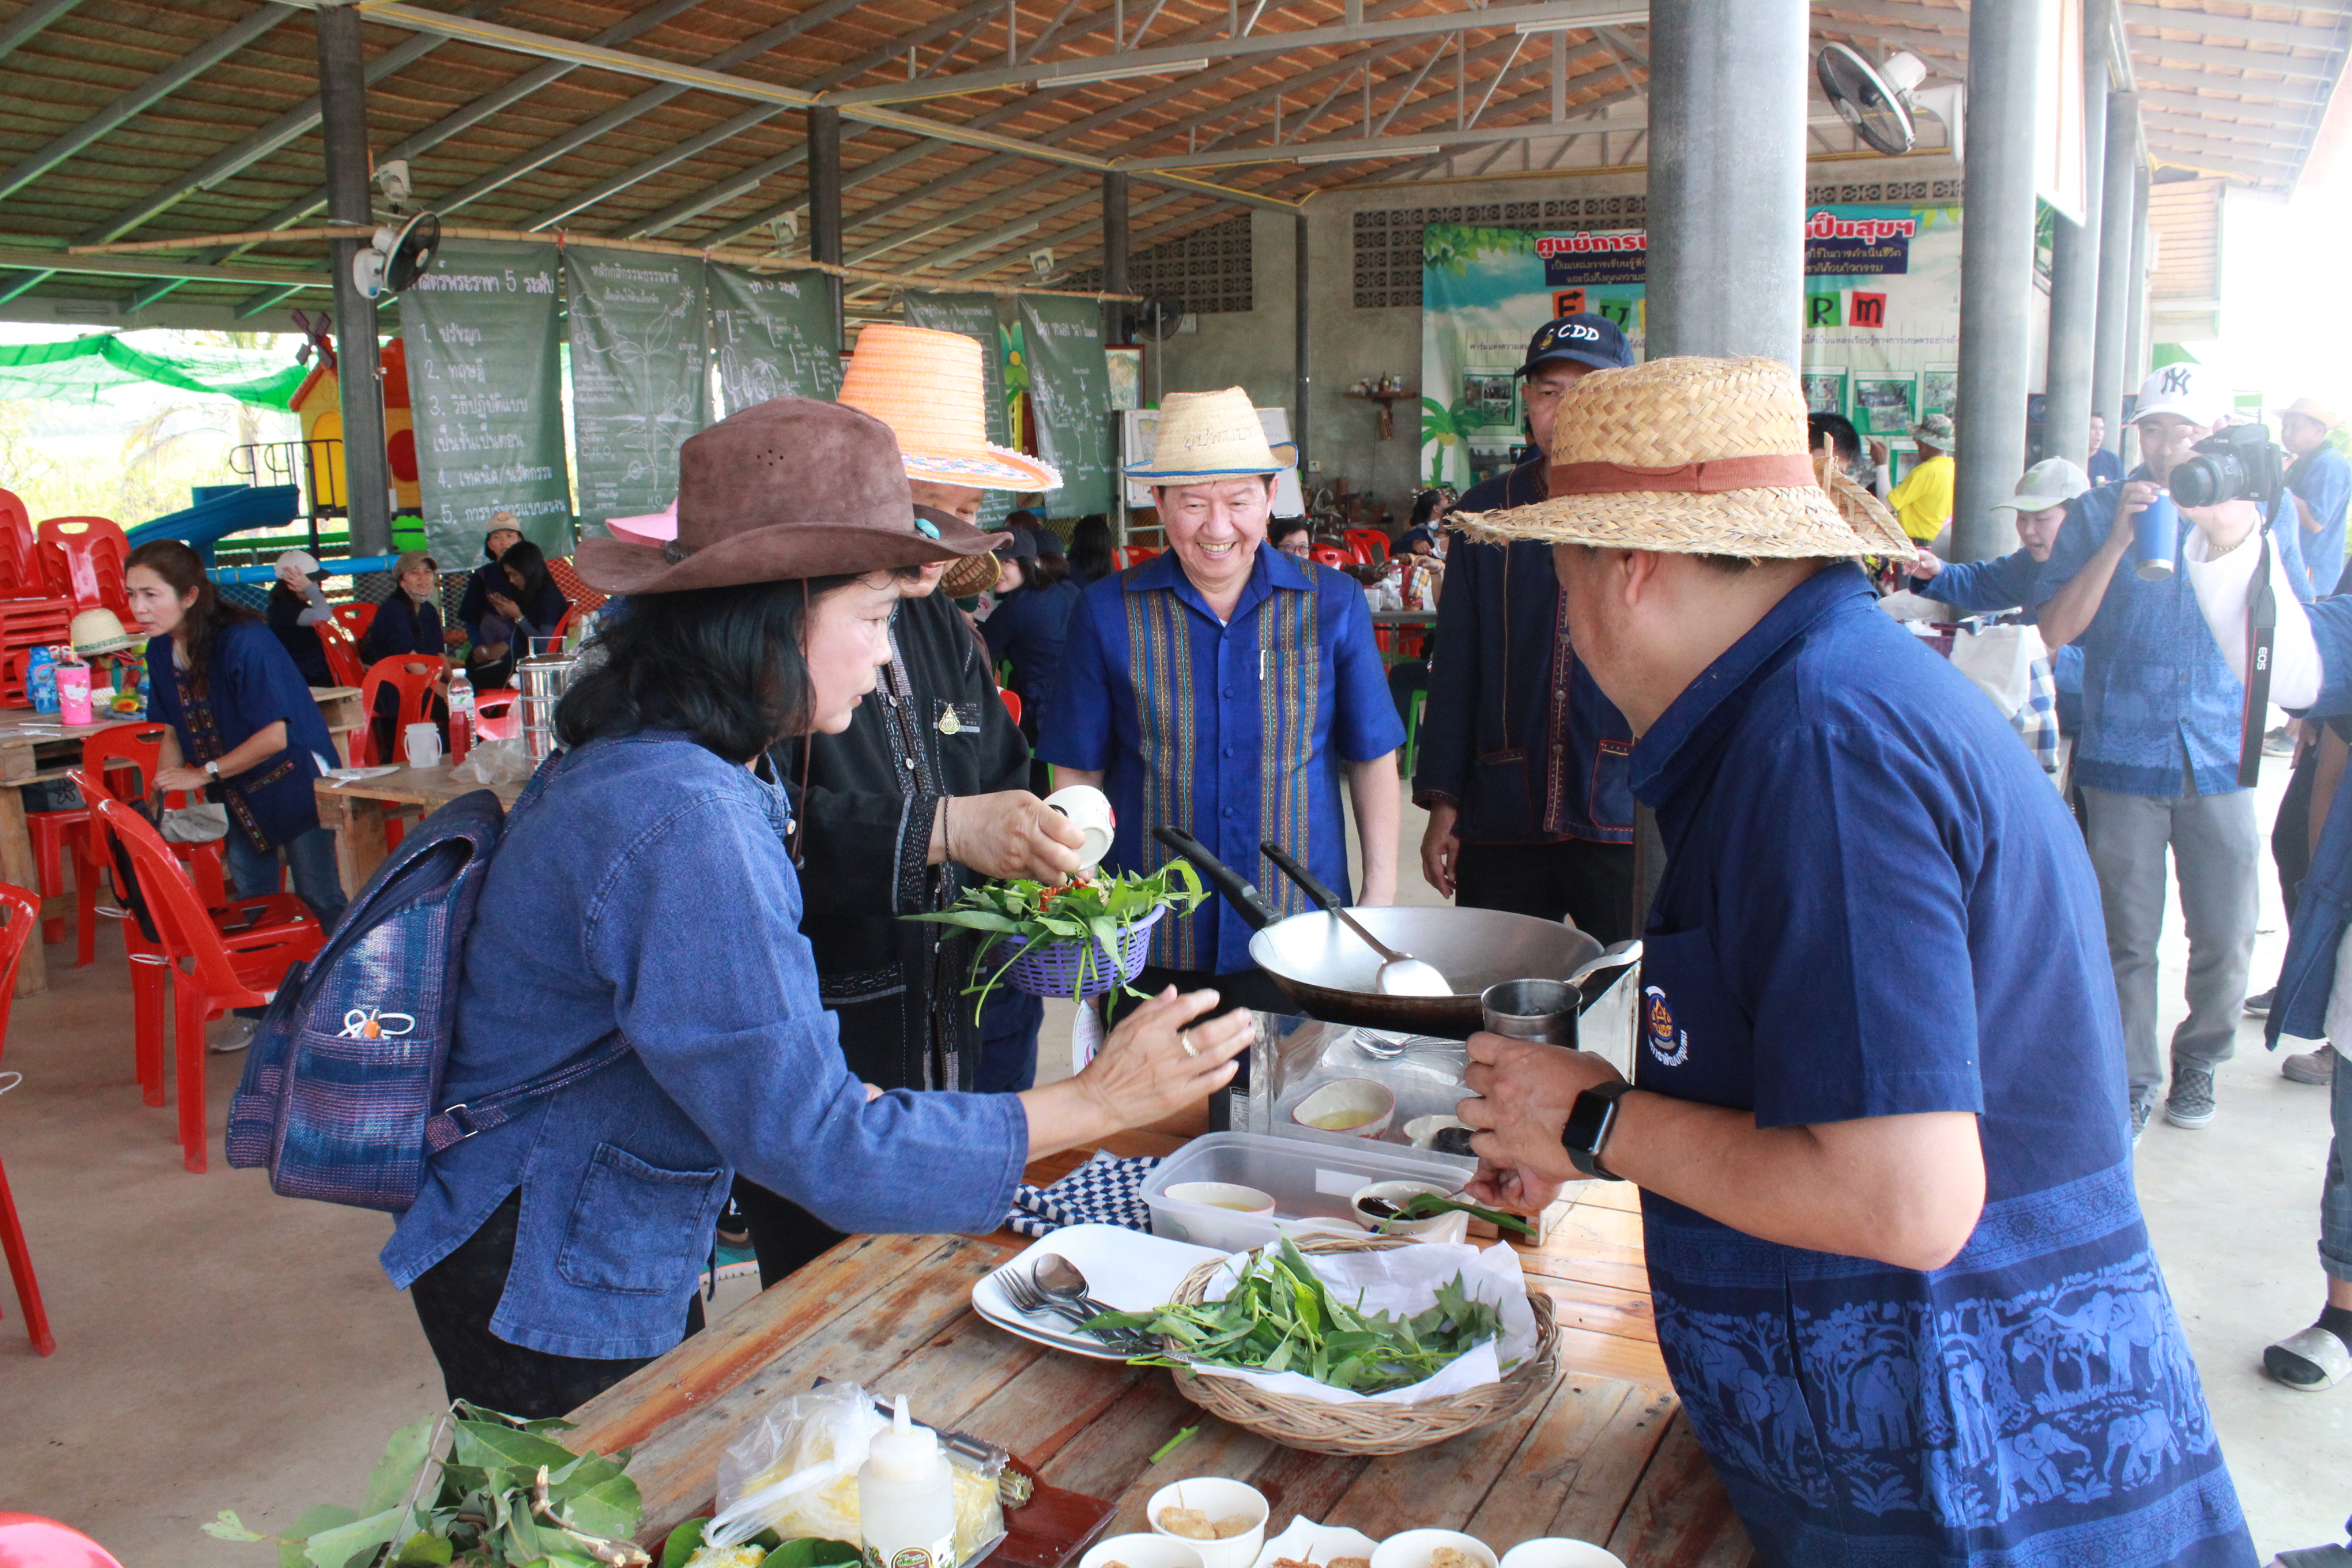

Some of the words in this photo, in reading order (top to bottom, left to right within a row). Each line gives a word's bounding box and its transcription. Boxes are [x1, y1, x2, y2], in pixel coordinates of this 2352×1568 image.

[407, 260, 499, 292] าสตร์พระราชา
[504, 270, 517, 293] 5
[523, 271, 555, 293] ระดับ
[419, 323, 432, 343] 1.
[439, 322, 482, 346] ปรัชญา
[1558, 323, 1599, 340] CDD
[425, 359, 440, 380] 2.
[448, 358, 486, 384] ทฤษฎี
[429, 395, 445, 416] 3.
[451, 393, 528, 419] วิธีปฏิบัติแบบ
[433, 422, 525, 453] เป็นขั้นเป็นตอน
[438, 468, 452, 488] 4.
[459, 463, 553, 487] เทคนิค/นวัตกรรม
[441, 504, 457, 525] 5.
[2256, 647, 2268, 670] EOS
